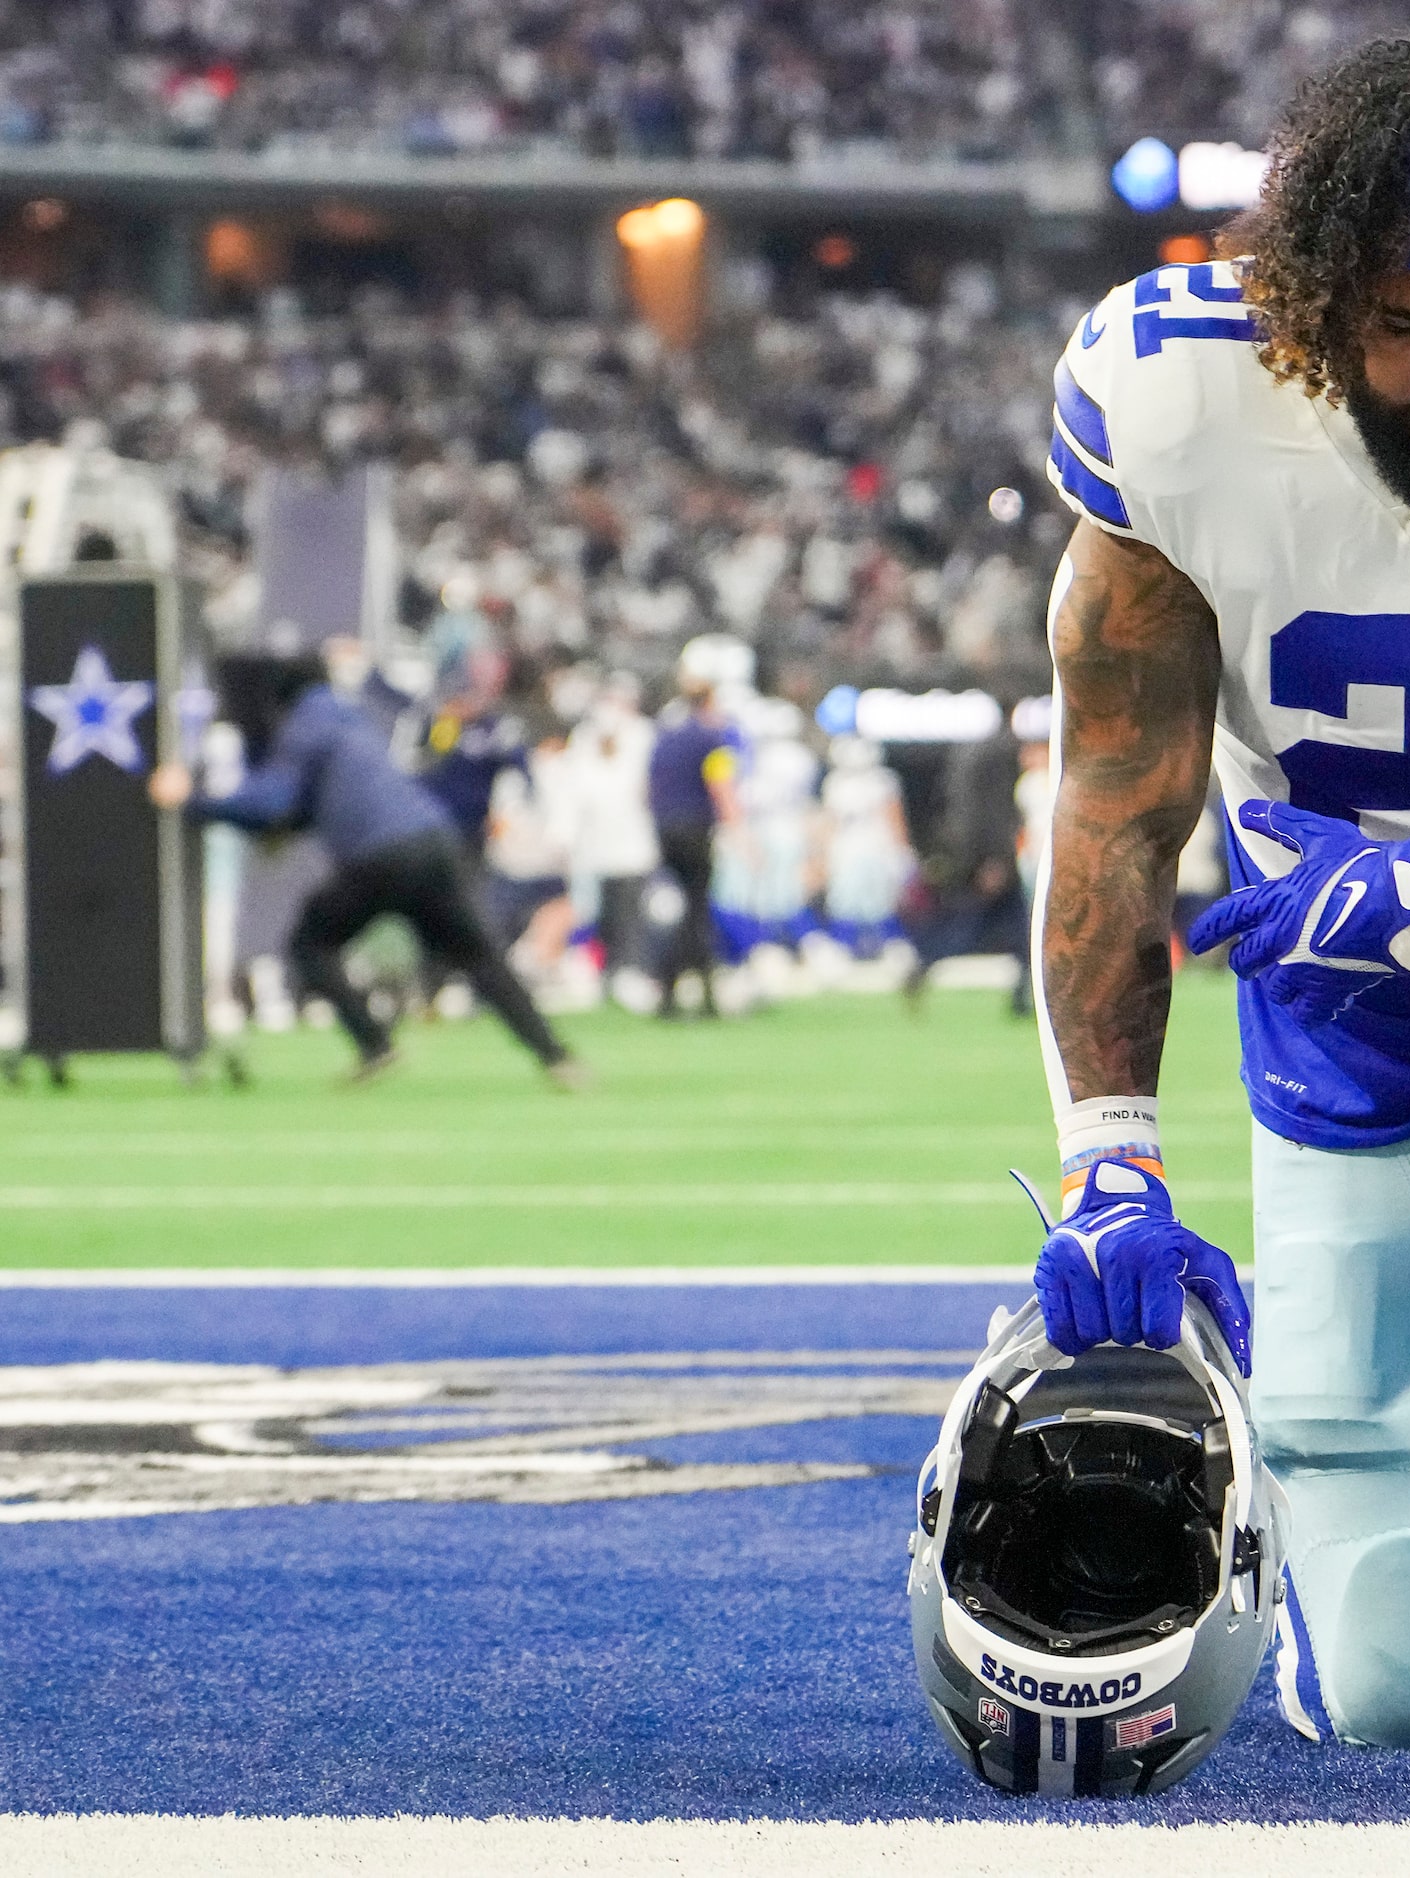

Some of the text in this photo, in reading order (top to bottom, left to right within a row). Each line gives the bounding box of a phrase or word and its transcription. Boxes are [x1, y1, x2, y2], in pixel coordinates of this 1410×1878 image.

[1264, 1070, 1308, 1094] DRI-FIT
[1102, 1110, 1129, 1121] FIND
[1132, 1110, 1140, 1120] A
[981, 1653, 1141, 1708] COWBOYS
[982, 1703, 1006, 1720] NFL
